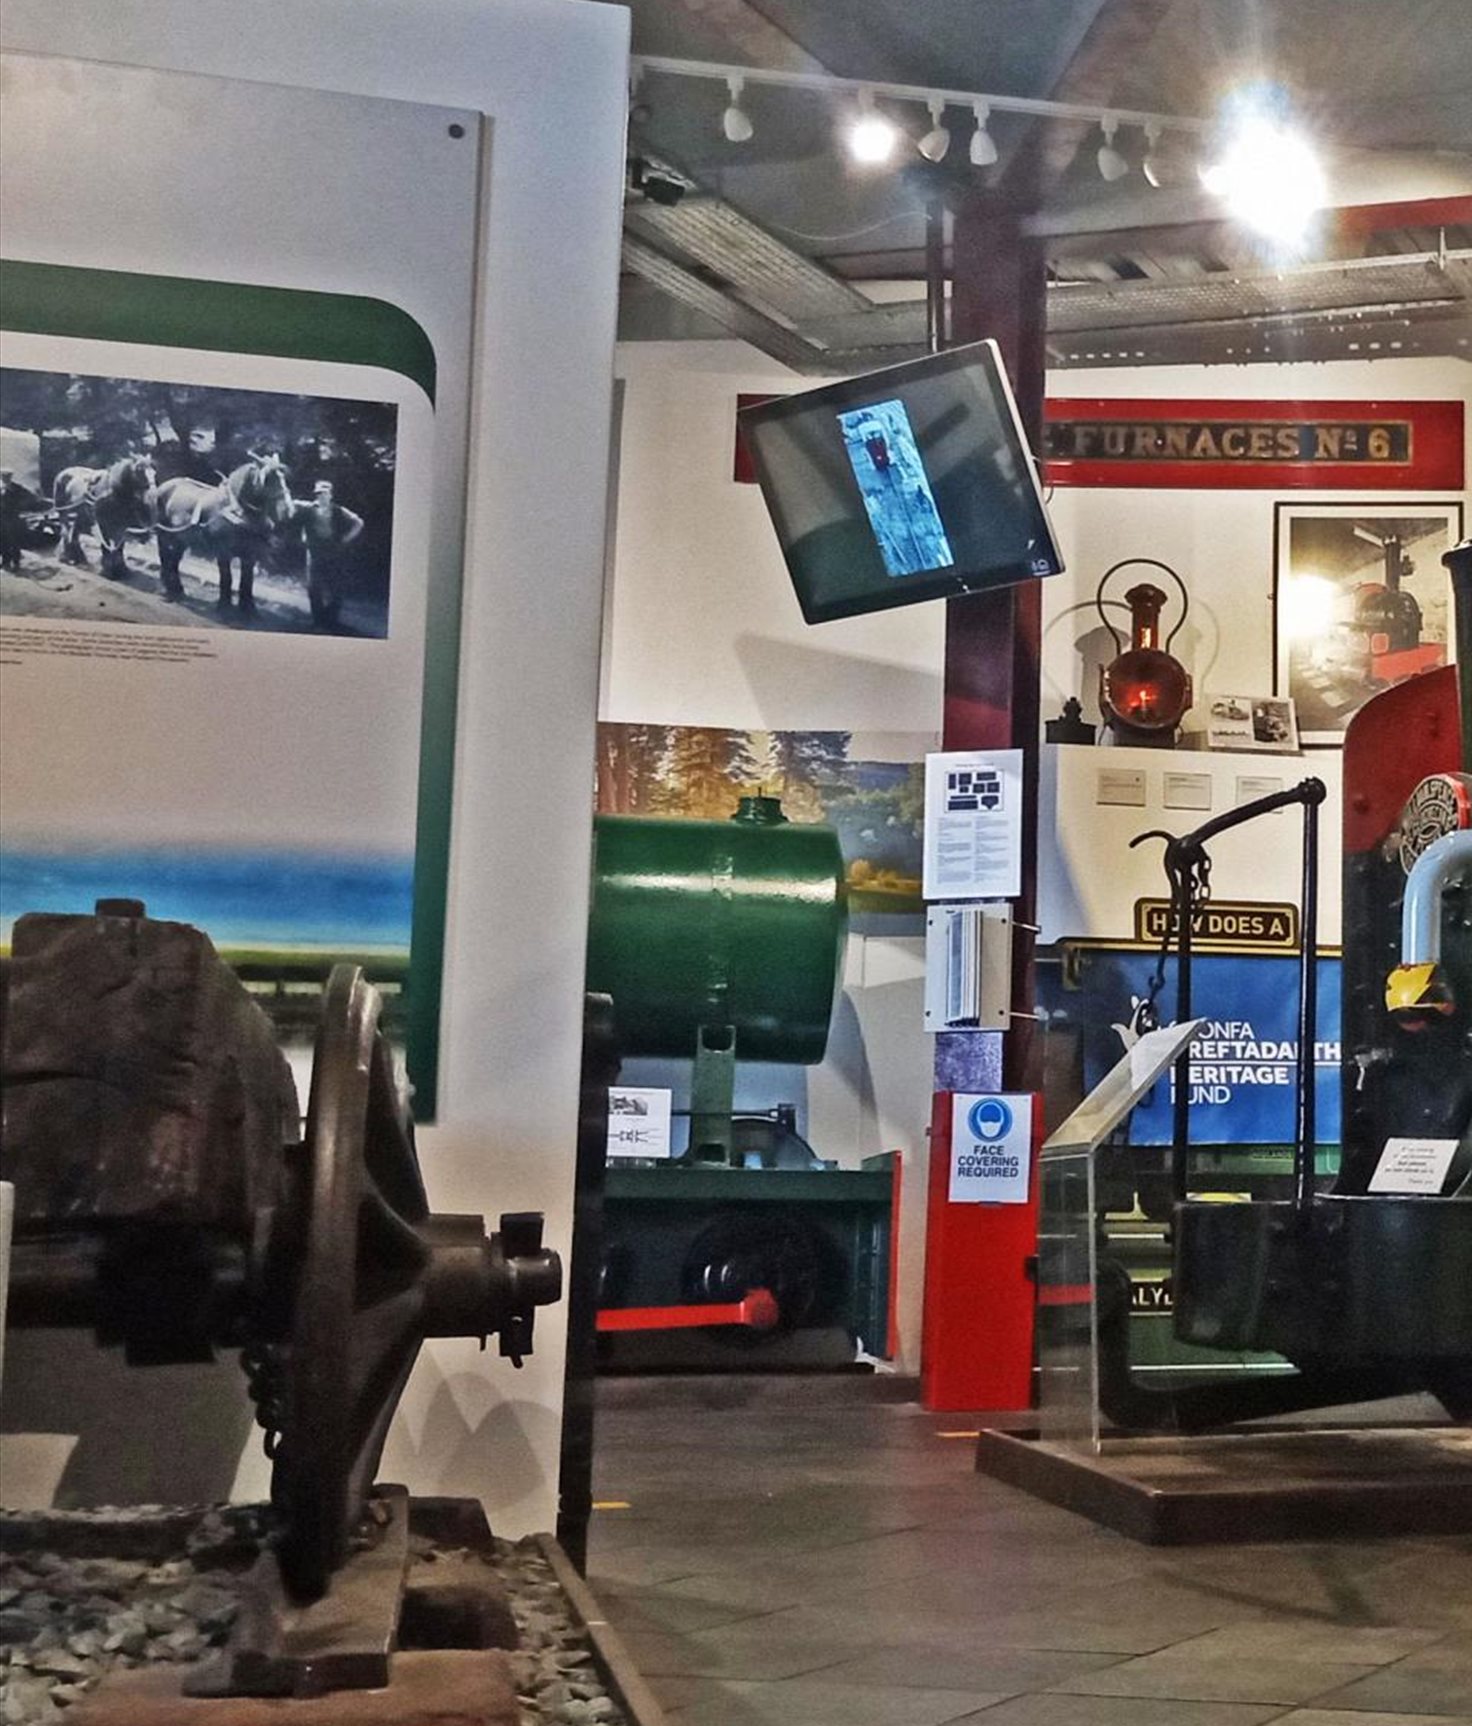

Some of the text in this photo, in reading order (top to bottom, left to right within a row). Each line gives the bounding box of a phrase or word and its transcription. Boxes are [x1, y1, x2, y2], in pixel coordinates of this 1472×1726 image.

[1073, 425, 1300, 459] FURNACES
[1367, 427, 1390, 460] 6
[1208, 915, 1264, 935] DOES
[1269, 917, 1284, 936] A
[1169, 1021, 1255, 1040] ONFA
[1189, 1041, 1342, 1061] REFTADATH
[1170, 1066, 1290, 1085] ERITAGE
[1170, 1086, 1231, 1105] UND
[973, 1145, 1005, 1156] FACE
[957, 1156, 1019, 1167] COVERING
[957, 1167, 1019, 1178] REQUIRED
